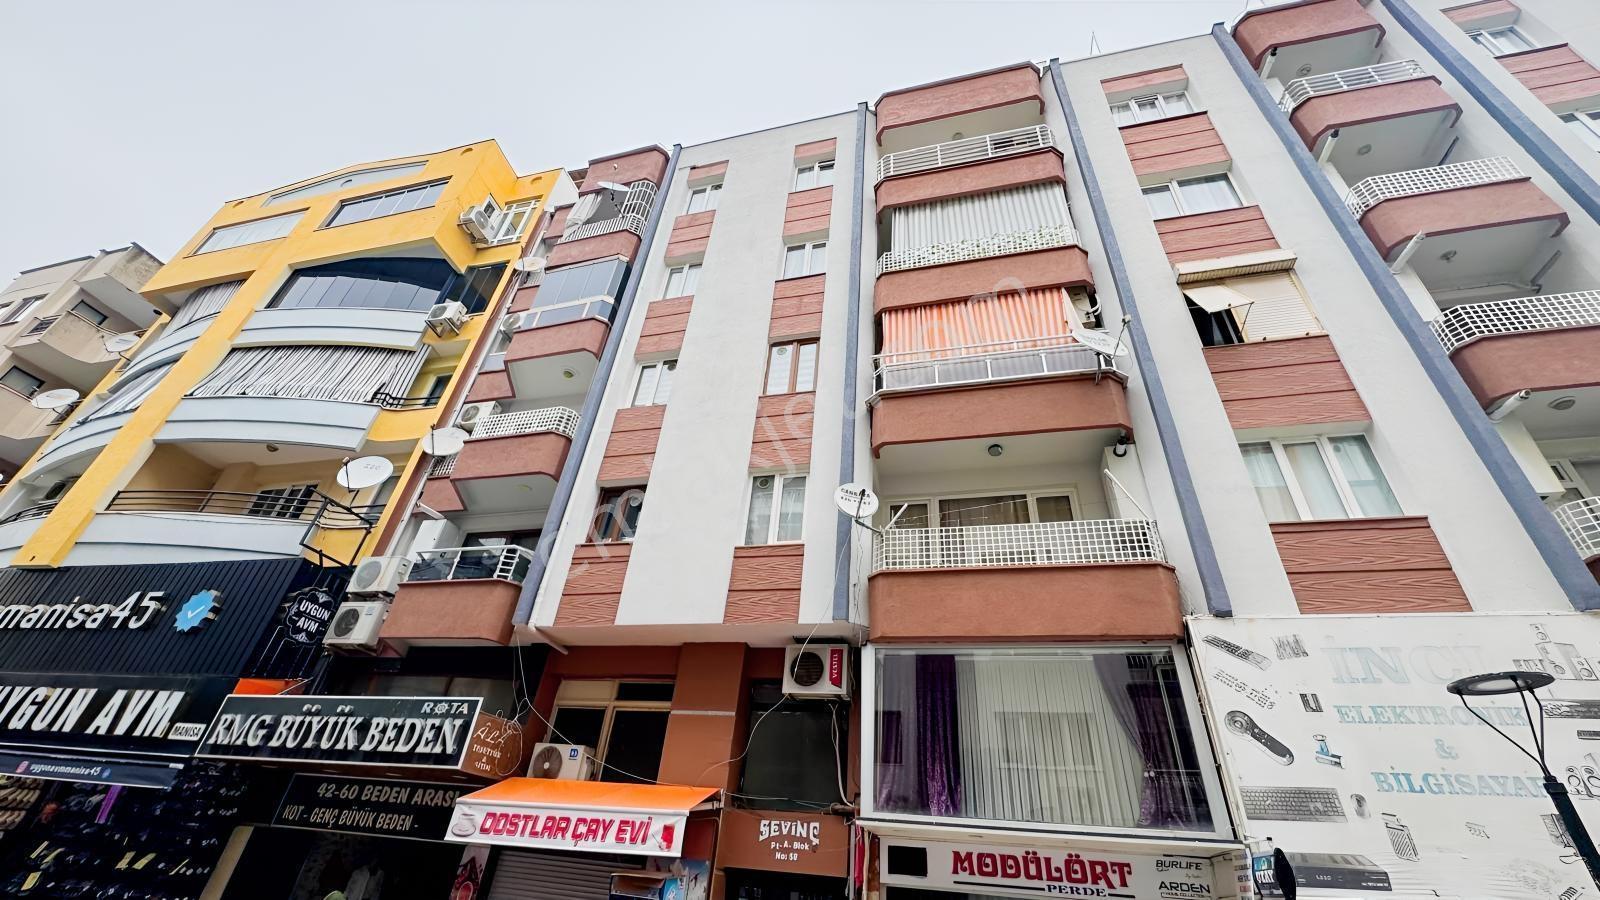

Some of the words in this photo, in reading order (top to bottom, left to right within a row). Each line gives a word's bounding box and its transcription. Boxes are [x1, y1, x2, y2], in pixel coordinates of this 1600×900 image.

[0, 591, 165, 629] manisa45
[299, 600, 332, 621] UYGUN
[296, 616, 319, 633] AVM
[84, 688, 186, 738] AVM
[208, 713, 272, 747] RMG
[269, 704, 364, 750] BÜYÜK
[360, 716, 465, 754] BEDEN
[1433, 738, 1460, 761] &
[316, 782, 358, 800] 42-60
[361, 784, 412, 804] BEDEN
[411, 787, 460, 808] ARASI
[282, 804, 303, 821] KOT
[310, 806, 338, 828] GENÇ
[338, 806, 375, 829] BÜYÜK
[375, 812, 414, 831] BEDEN
[479, 812, 573, 840] DOSTLAR
[571, 817, 616, 847] ÇAY
[614, 816, 653, 846] EVİ
[758, 819, 820, 846] SEVİNÇ
[792, 841, 810, 850] Blok
[951, 850, 1133, 889] MODÜLÖRT
[1046, 884, 1107, 897] PERDE
[1158, 881, 1211, 894] ARDEN
